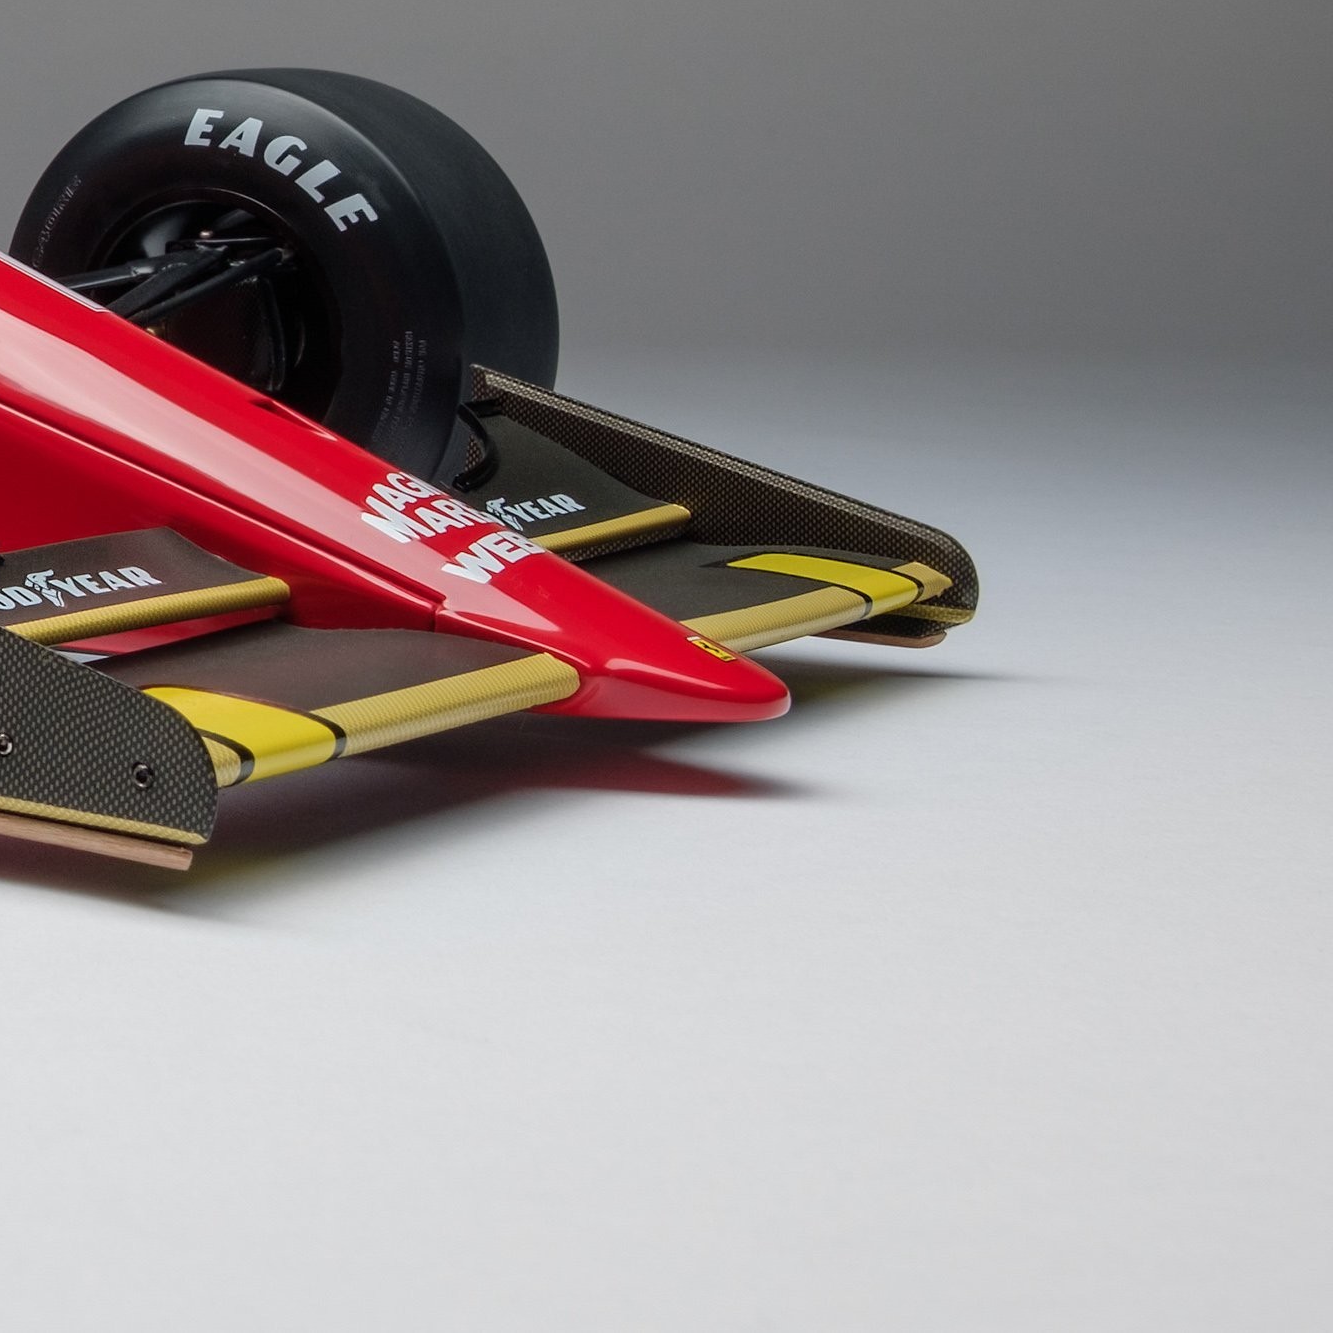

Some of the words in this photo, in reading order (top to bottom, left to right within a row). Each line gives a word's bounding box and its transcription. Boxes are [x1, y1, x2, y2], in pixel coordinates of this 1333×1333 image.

[183, 108, 378, 232] EAGLE
[503, 493, 586, 527] YEAR
[441, 531, 545, 584] WEB
